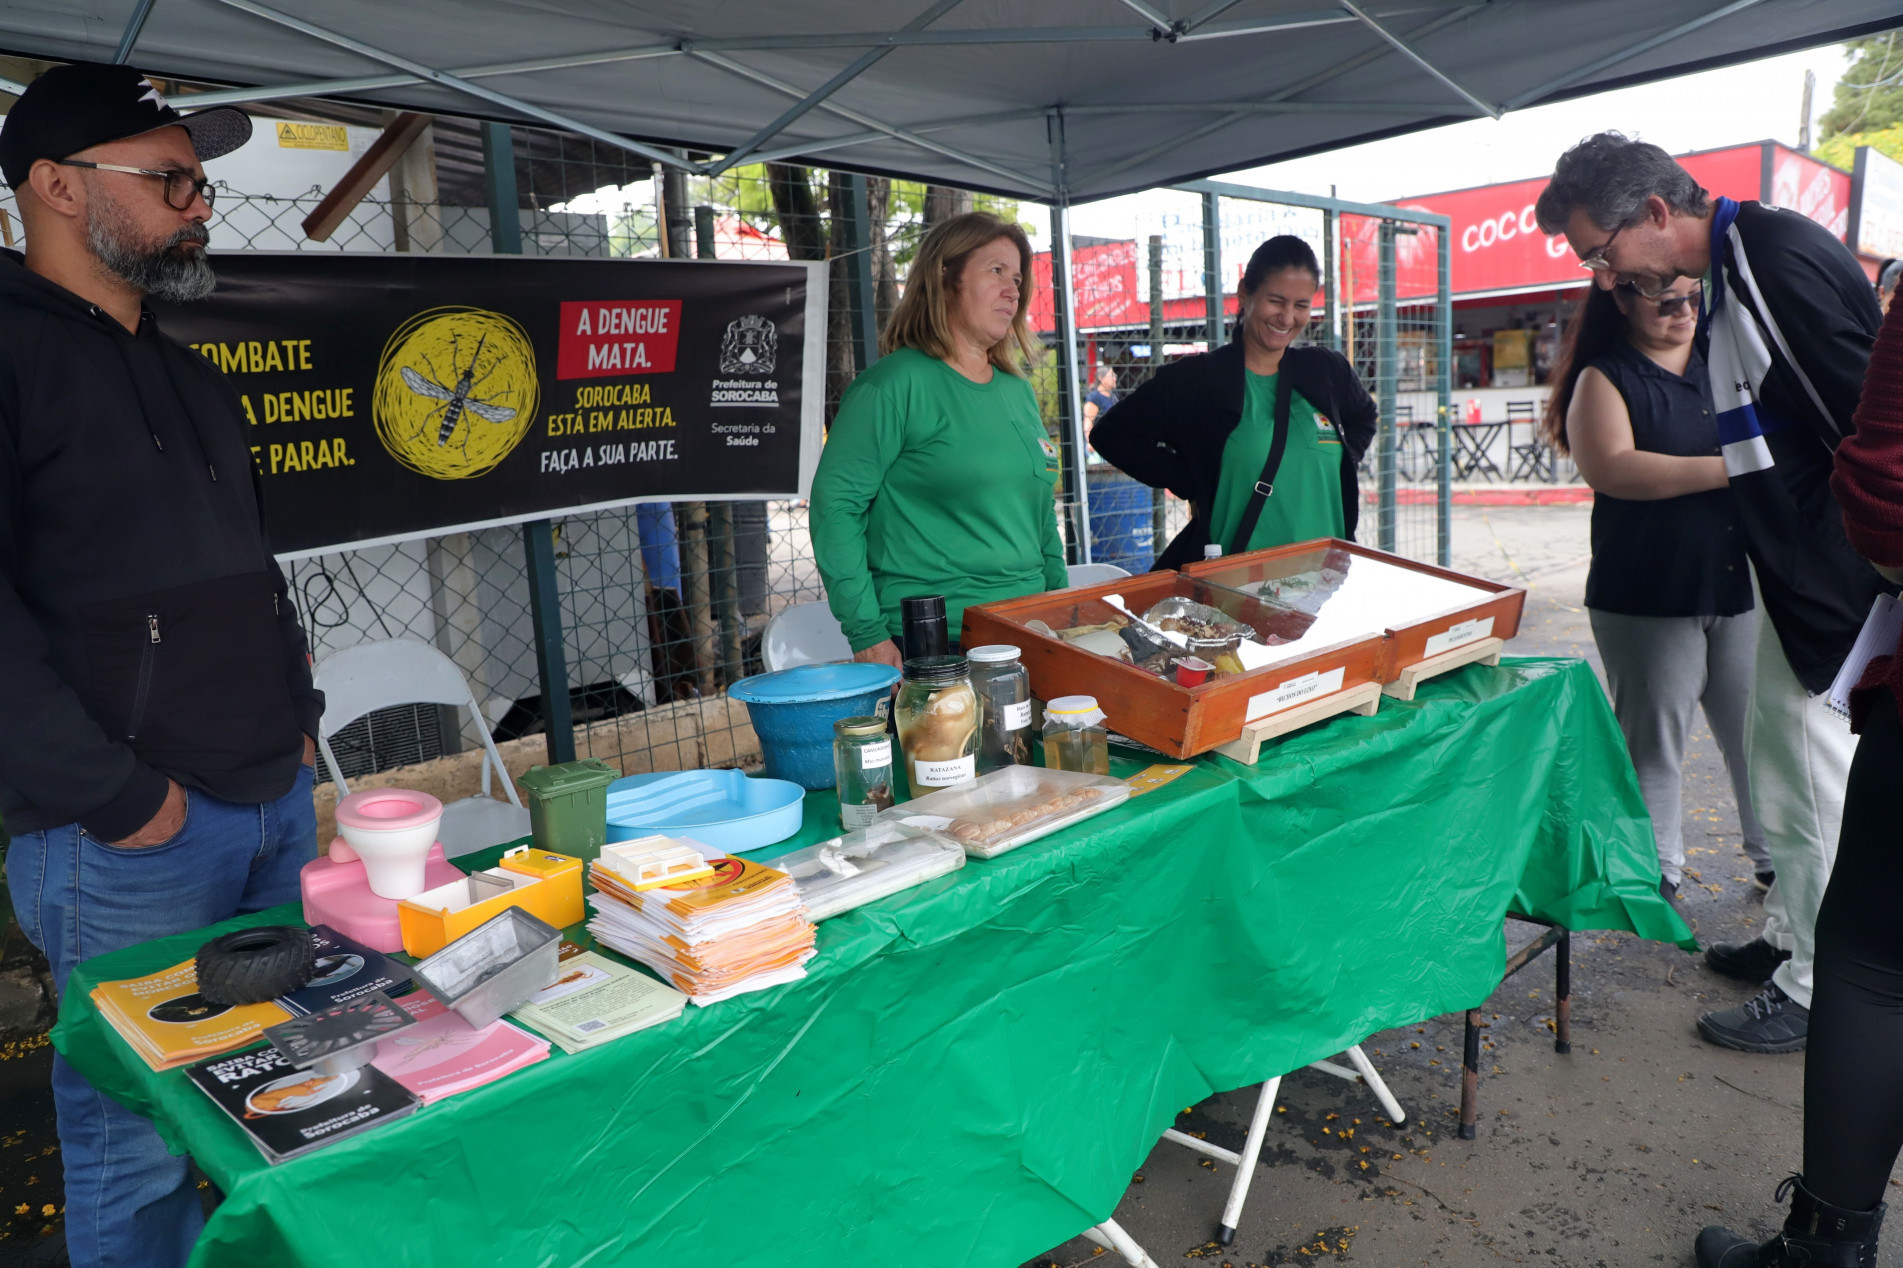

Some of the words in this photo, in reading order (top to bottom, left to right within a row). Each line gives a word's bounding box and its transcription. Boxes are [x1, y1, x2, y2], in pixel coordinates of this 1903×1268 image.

[1546, 233, 1577, 258] G
[576, 308, 592, 335] A
[598, 308, 670, 335] DENGUE
[588, 342, 652, 370] MATA.
[575, 383, 651, 409] SOROCABA
[711, 390, 779, 402] SOROCABA
[712, 379, 762, 389] Prefeitura
[764, 380, 778, 389] de
[263, 388, 354, 424] DENGUE
[548, 409, 585, 437] ESTÁ
[589, 410, 614, 433] EM
[617, 406, 677, 430] ALERTA.
[711, 422, 760, 434] Secretaria
[762, 423, 776, 434] da
[726, 435, 759, 447] Saúde
[270, 437, 356, 475] PARAR.
[541, 448, 579, 475] FAÇA
[582, 446, 594, 468] A
[598, 443, 625, 466] SUA
[629, 439, 679, 463] PARTE.
[929, 765, 962, 773] RATAZANA
[119, 977, 163, 990] SAIBA
[165, 965, 198, 979] COM
[131, 979, 182, 993] EVITAR
[132, 977, 198, 998] MORCEGO
[330, 981, 374, 1000] Prefeitura
[374, 976, 387, 985] de
[334, 978, 394, 1004] Sorocaba
[193, 1022, 261, 1045] Sorocaba
[206, 1055, 255, 1072] SAIBA
[257, 1047, 279, 1057] CO
[212, 1054, 282, 1077] EVITAR
[217, 1056, 293, 1084] RATO
[474, 1048, 515, 1070] Sorocaba
[300, 1110, 356, 1134] Prefeitura
[357, 1103, 372, 1113] de
[303, 1106, 381, 1139] Sorocaba
